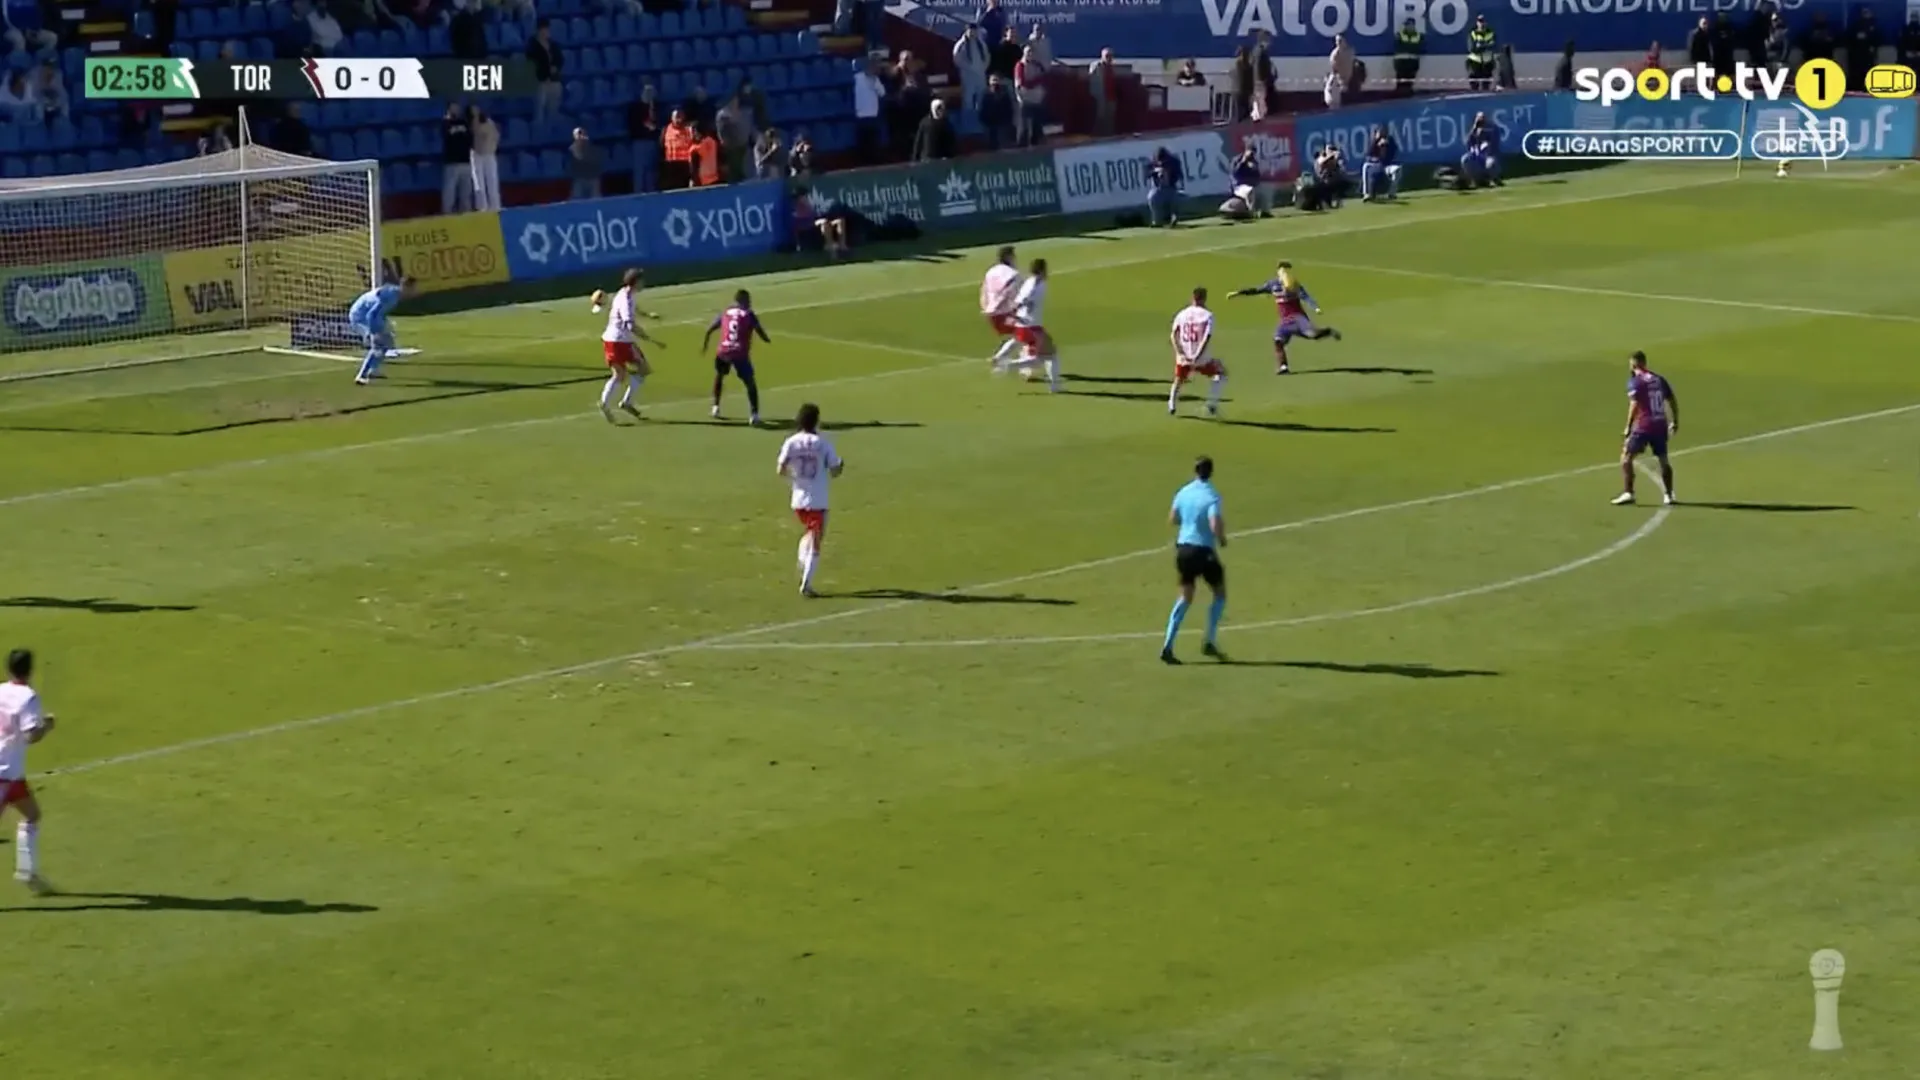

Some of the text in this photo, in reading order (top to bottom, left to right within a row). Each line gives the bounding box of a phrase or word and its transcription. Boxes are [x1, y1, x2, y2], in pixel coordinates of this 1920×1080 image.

[1063, 162, 1105, 197] LIGA
[1105, 149, 1196, 193] PORTL
[1195, 147, 1210, 180] 2
[556, 210, 640, 263] xplor
[698, 197, 775, 247] xplor
